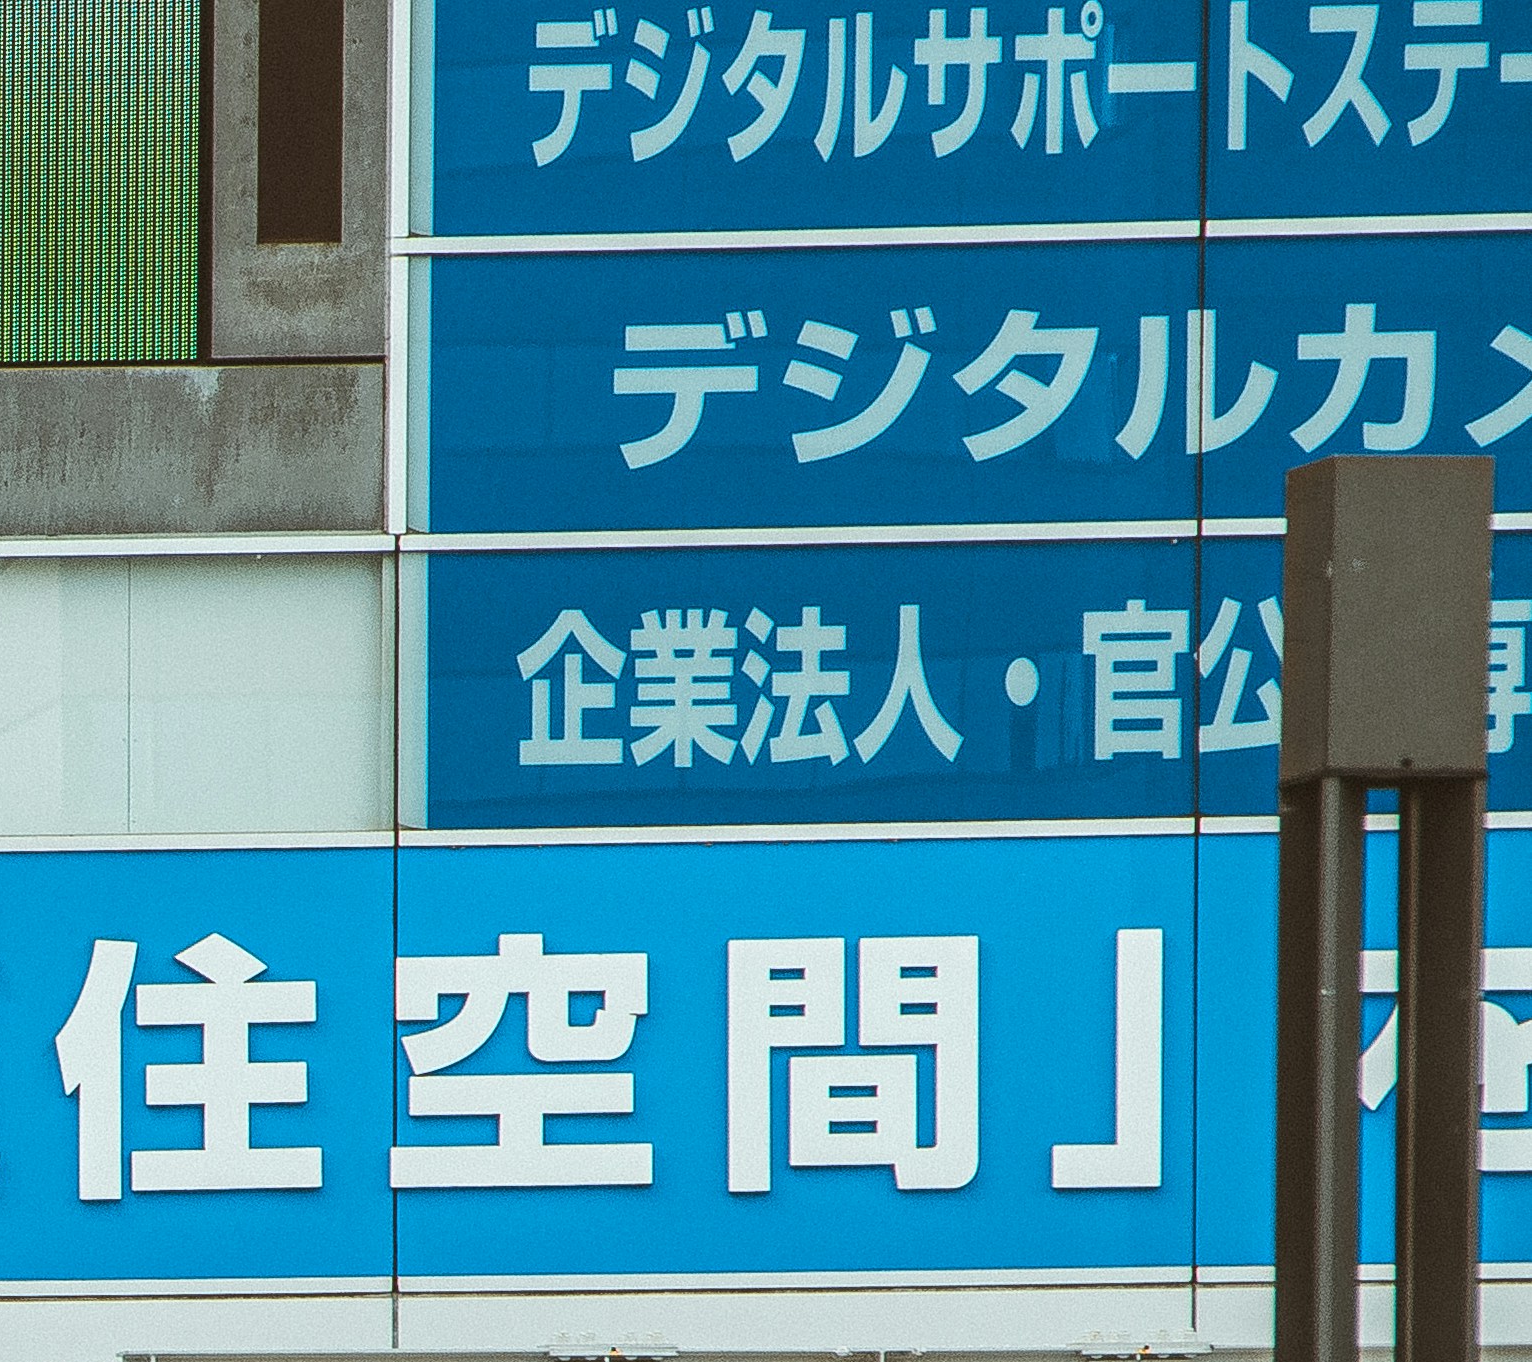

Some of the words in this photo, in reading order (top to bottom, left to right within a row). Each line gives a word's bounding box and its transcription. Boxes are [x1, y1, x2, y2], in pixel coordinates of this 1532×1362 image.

[517, 597, 1532, 768] 企業法人・官公
